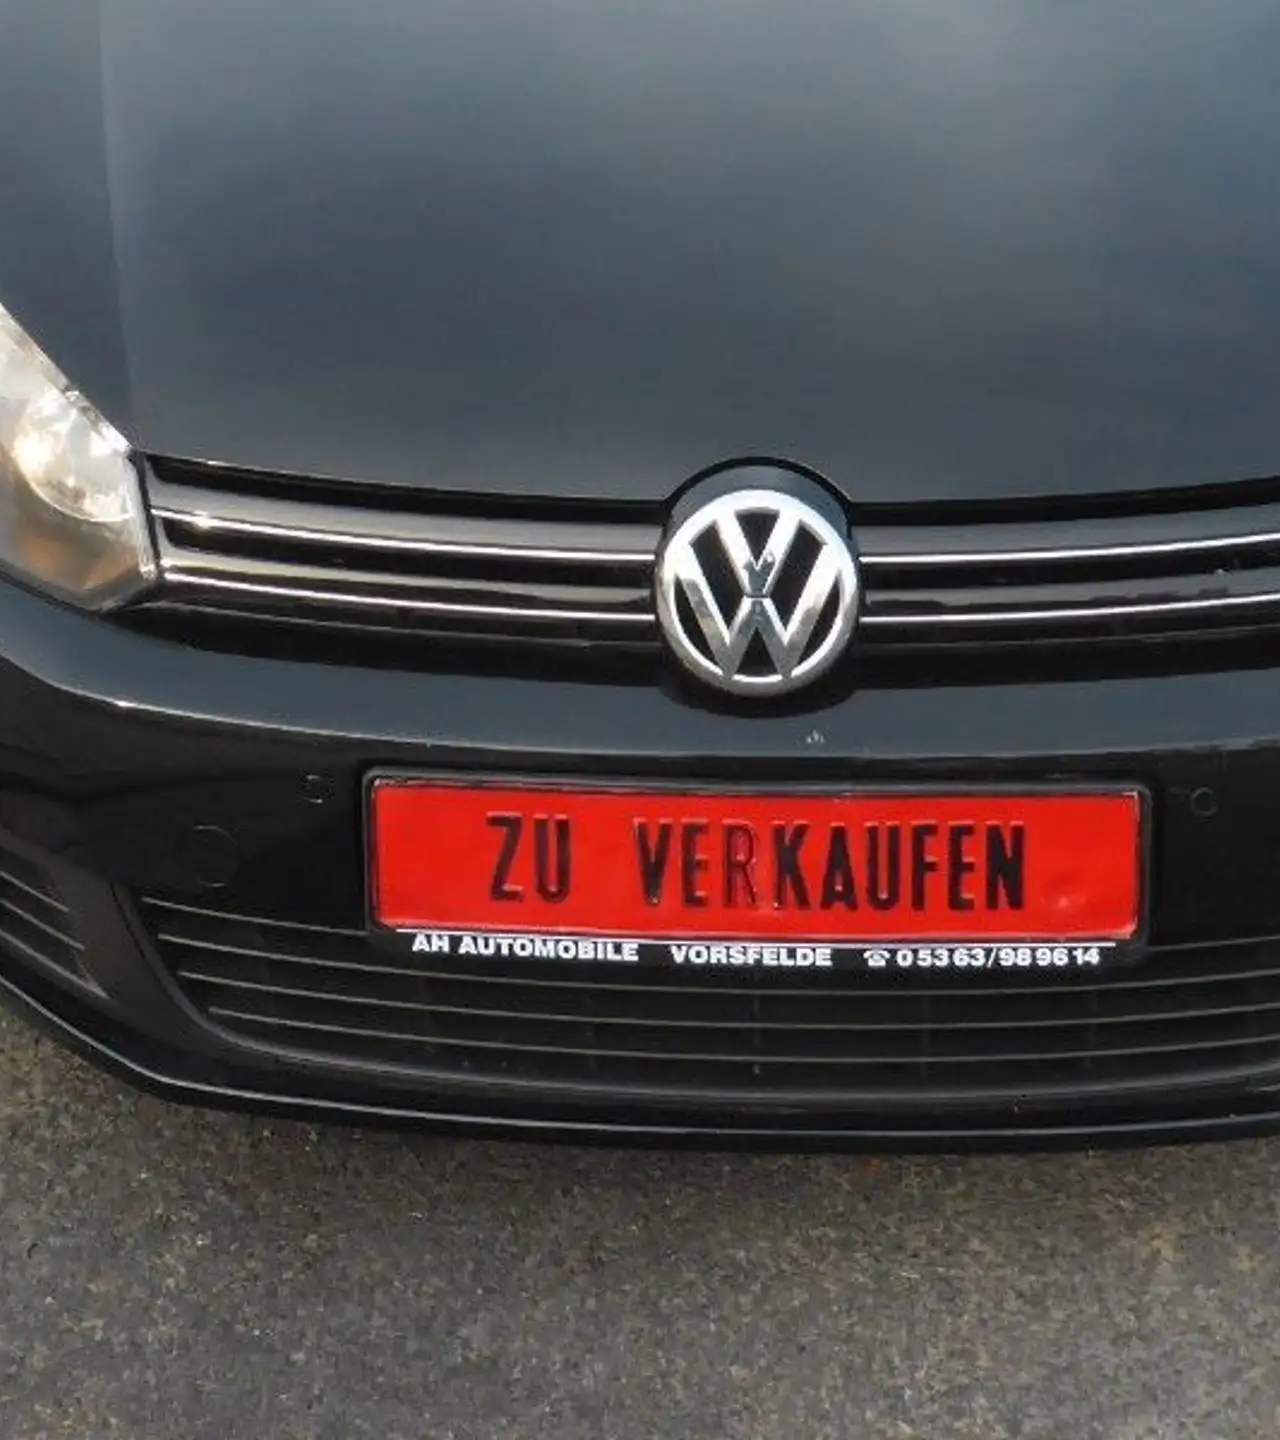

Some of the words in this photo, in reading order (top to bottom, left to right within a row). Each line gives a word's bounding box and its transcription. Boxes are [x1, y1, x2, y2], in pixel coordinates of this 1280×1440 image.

[486, 812, 571, 904] ZU
[632, 817, 1026, 912] VERKAUFEN
[412, 933, 450, 954] AH
[458, 935, 640, 962] AUTOMOBILE
[670, 944, 832, 967] VORSFELDE
